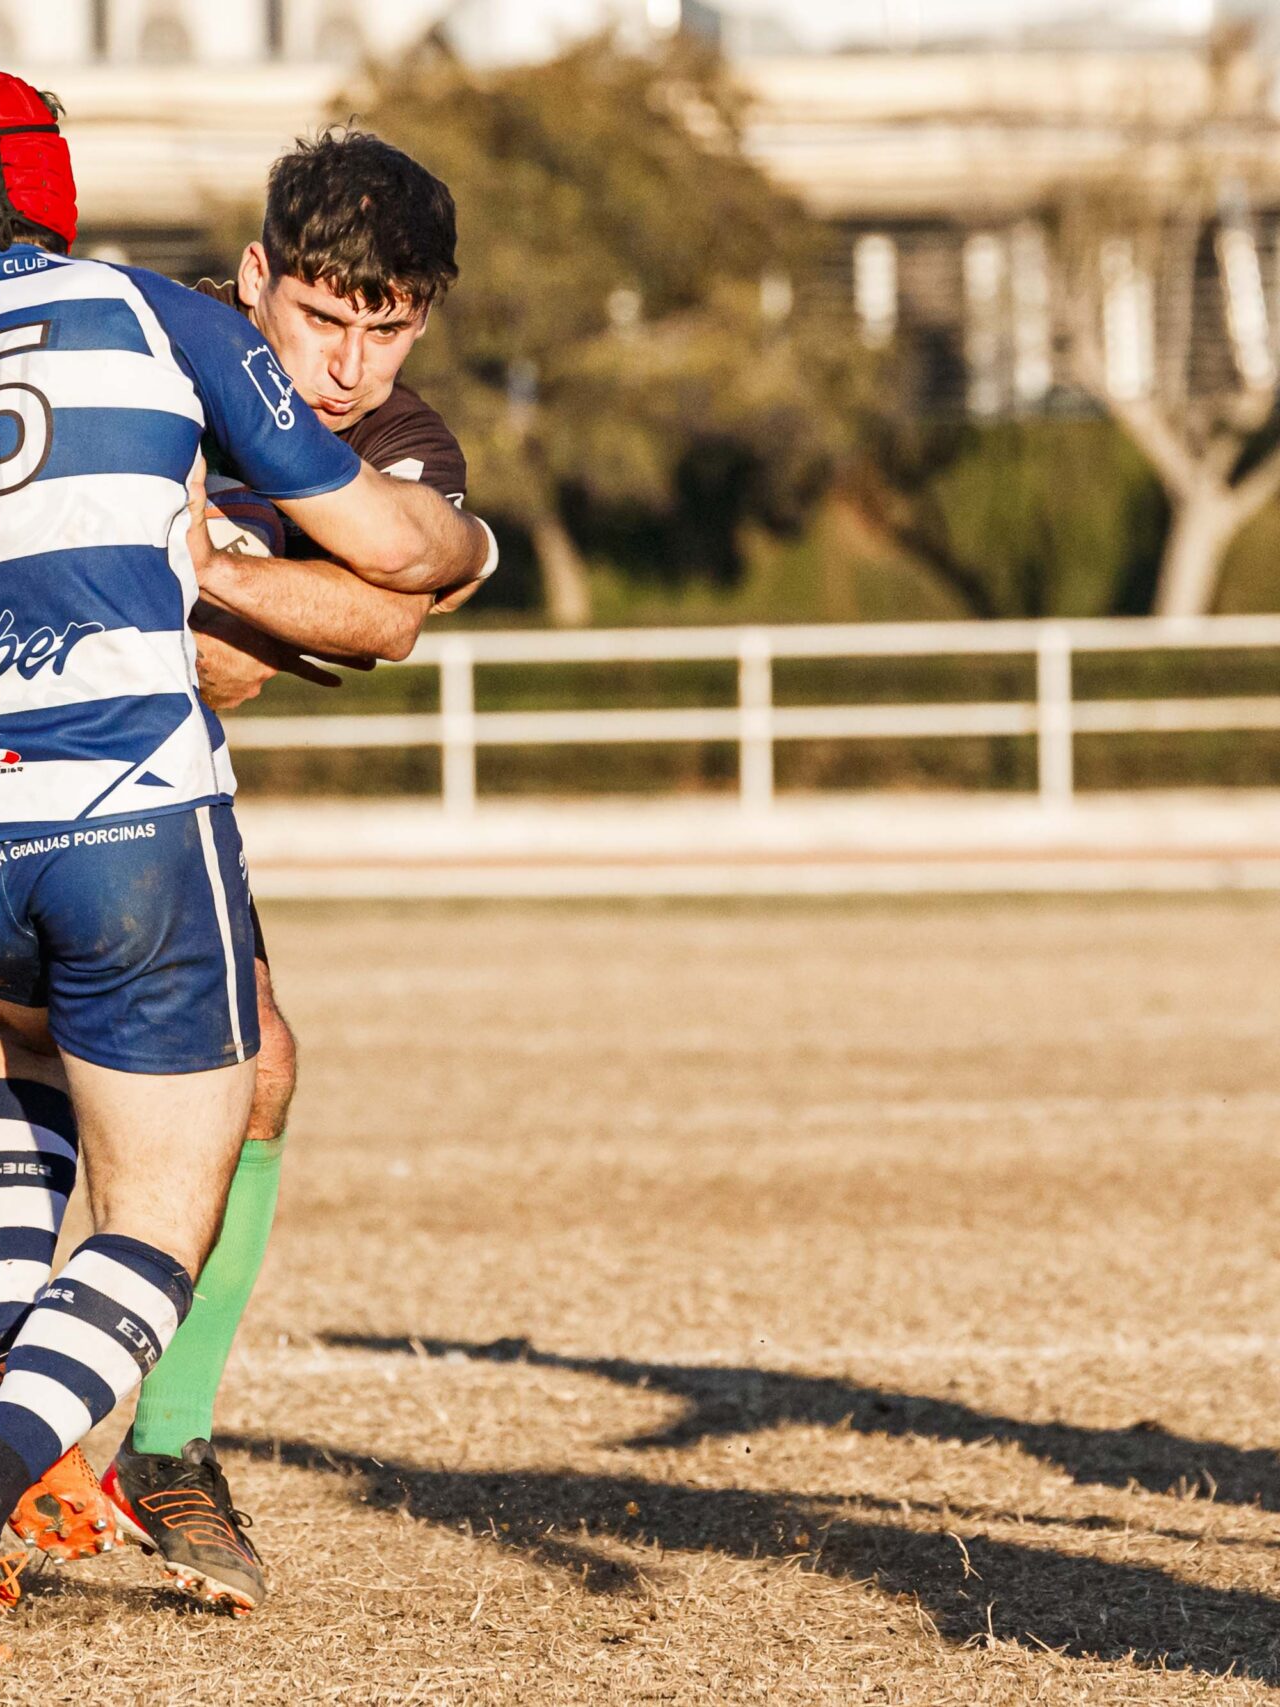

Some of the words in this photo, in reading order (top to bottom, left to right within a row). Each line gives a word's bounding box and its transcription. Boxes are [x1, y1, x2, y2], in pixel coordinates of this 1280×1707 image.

[3, 258, 49, 275] CLUB
[10, 834, 70, 860] GRANJAS
[73, 823, 156, 847] PORCINAS
